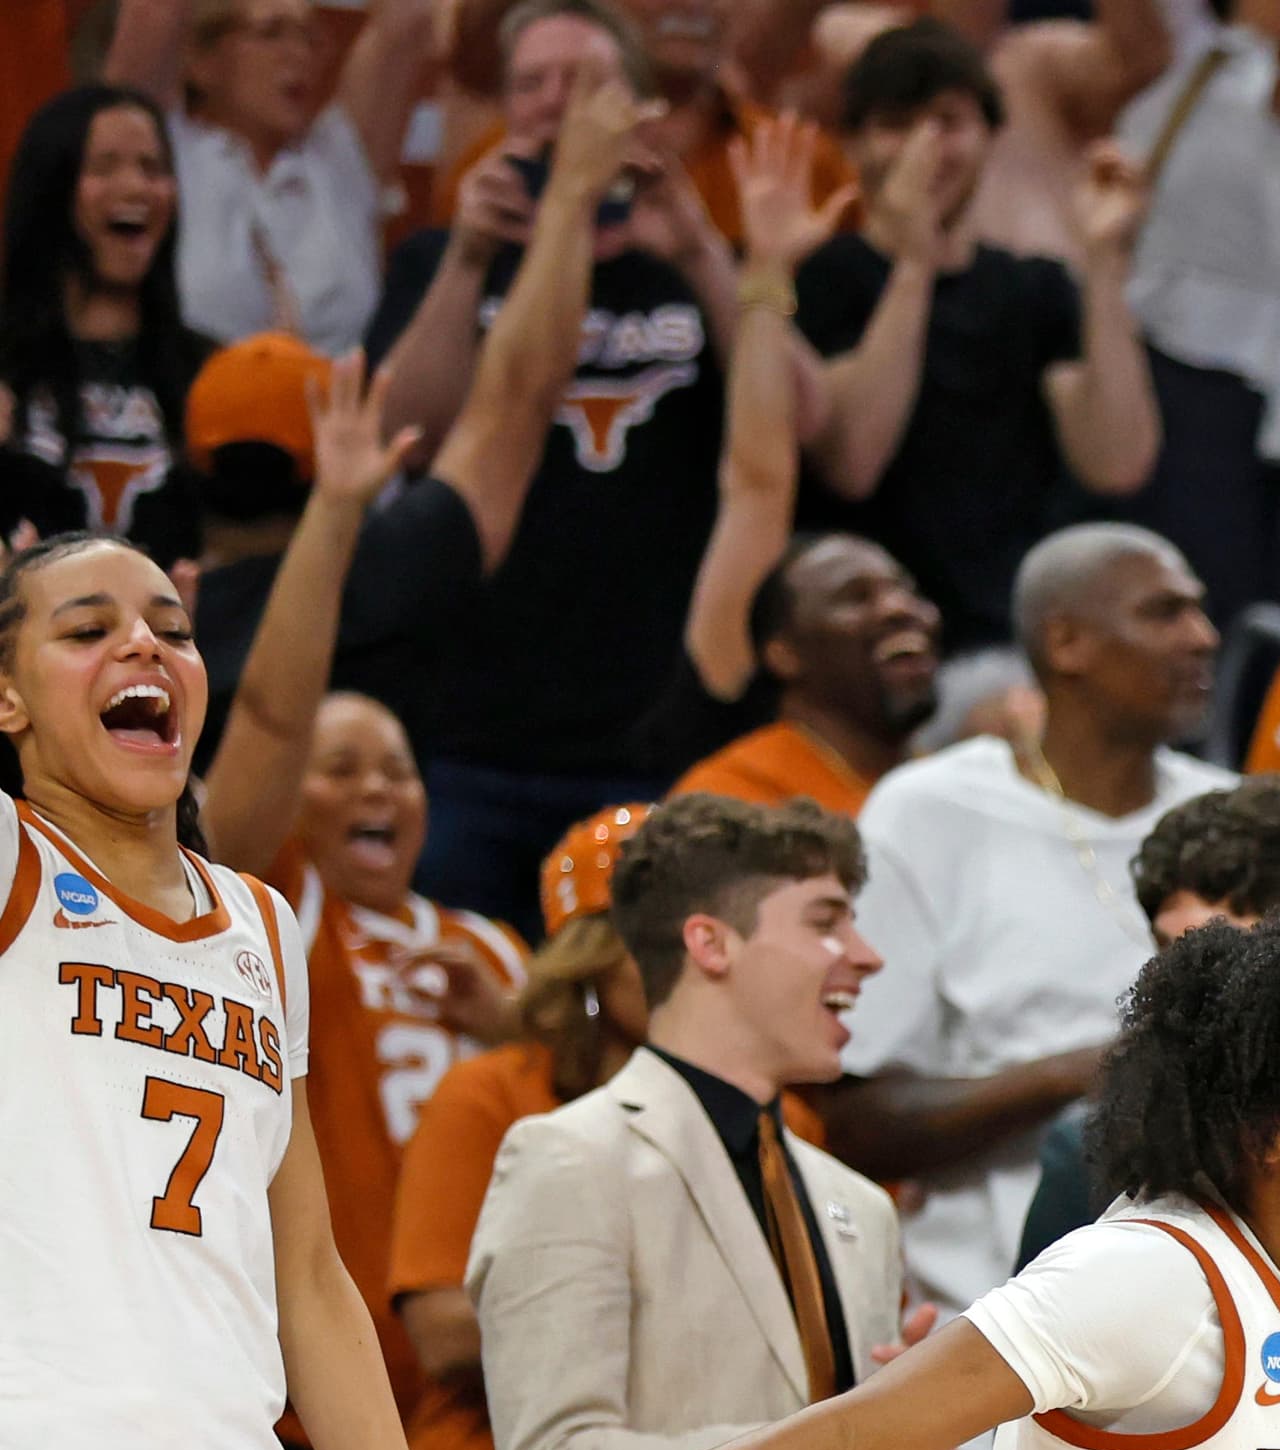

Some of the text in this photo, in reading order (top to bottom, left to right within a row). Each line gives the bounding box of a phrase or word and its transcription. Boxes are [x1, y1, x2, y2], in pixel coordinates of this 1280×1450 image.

[61, 890, 96, 906] NCAA
[59, 962, 282, 1095] TEXAS
[141, 1075, 225, 1237] 7
